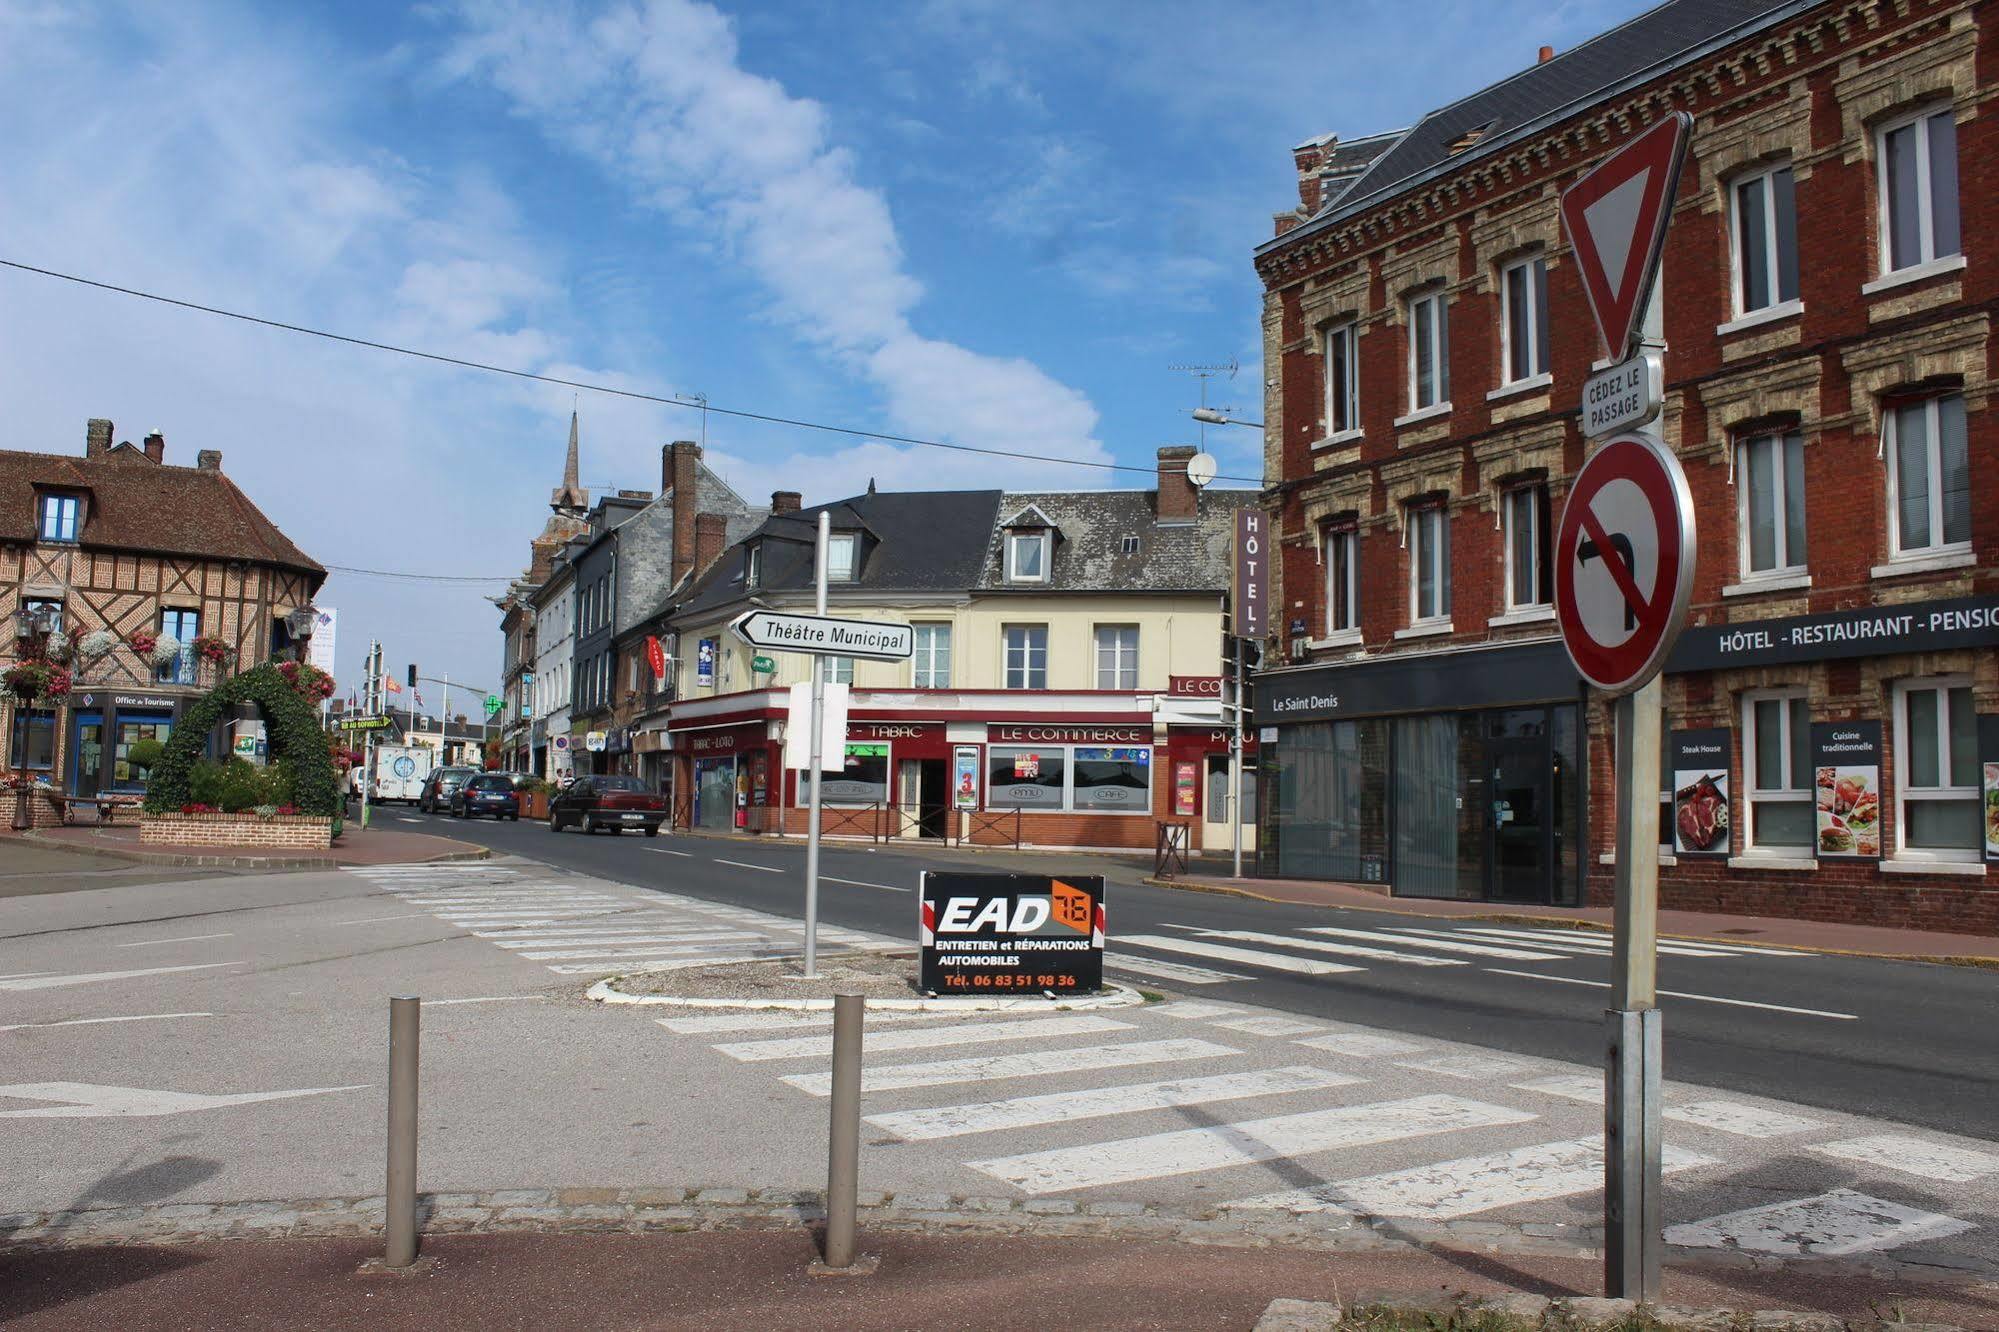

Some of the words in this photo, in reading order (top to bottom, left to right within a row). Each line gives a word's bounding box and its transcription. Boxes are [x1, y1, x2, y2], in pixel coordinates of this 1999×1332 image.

[1589, 375, 1622, 405] CÉDEZ
[1626, 368, 1639, 388] LE
[1591, 394, 1639, 428] PASSAGE
[1246, 516, 1258, 622] HÔTEL
[766, 621, 825, 642] Théâtre
[830, 627, 904, 650] Municipal
[1719, 630, 1774, 652] HÔTEL
[1792, 615, 1913, 645] RESTAURANT
[1177, 680, 1195, 693] LE
[115, 696, 136, 705] Office
[144, 697, 175, 707] Tourisme
[1273, 699, 1284, 712] Le
[1285, 697, 1309, 711] Saint
[1310, 694, 1338, 709] Denis
[869, 725, 923, 738] TABAC
[1001, 727, 1022, 740] LE
[1028, 728, 1140, 741] COMMERCE
[1832, 731, 1860, 741] Cuisine
[1682, 744, 1700, 754] Steak
[1701, 744, 1722, 753] House
[1822, 741, 1873, 752] traditionnelle
[937, 897, 1050, 933] EAD
[1054, 895, 1087, 921] 76
[935, 940, 999, 950] ENTRETIEN
[1000, 942, 1012, 950] et
[1014, 938, 1090, 951] RÉPARATIONS
[938, 955, 1020, 966] AUTOMOBILES
[944, 975, 969, 986] Tél.
[974, 975, 991, 986] 06
[995, 975, 1012, 986] 83
[1016, 975, 1032, 986] 51
[1037, 975, 1054, 986] 98
[1058, 975, 1075, 986] 36
